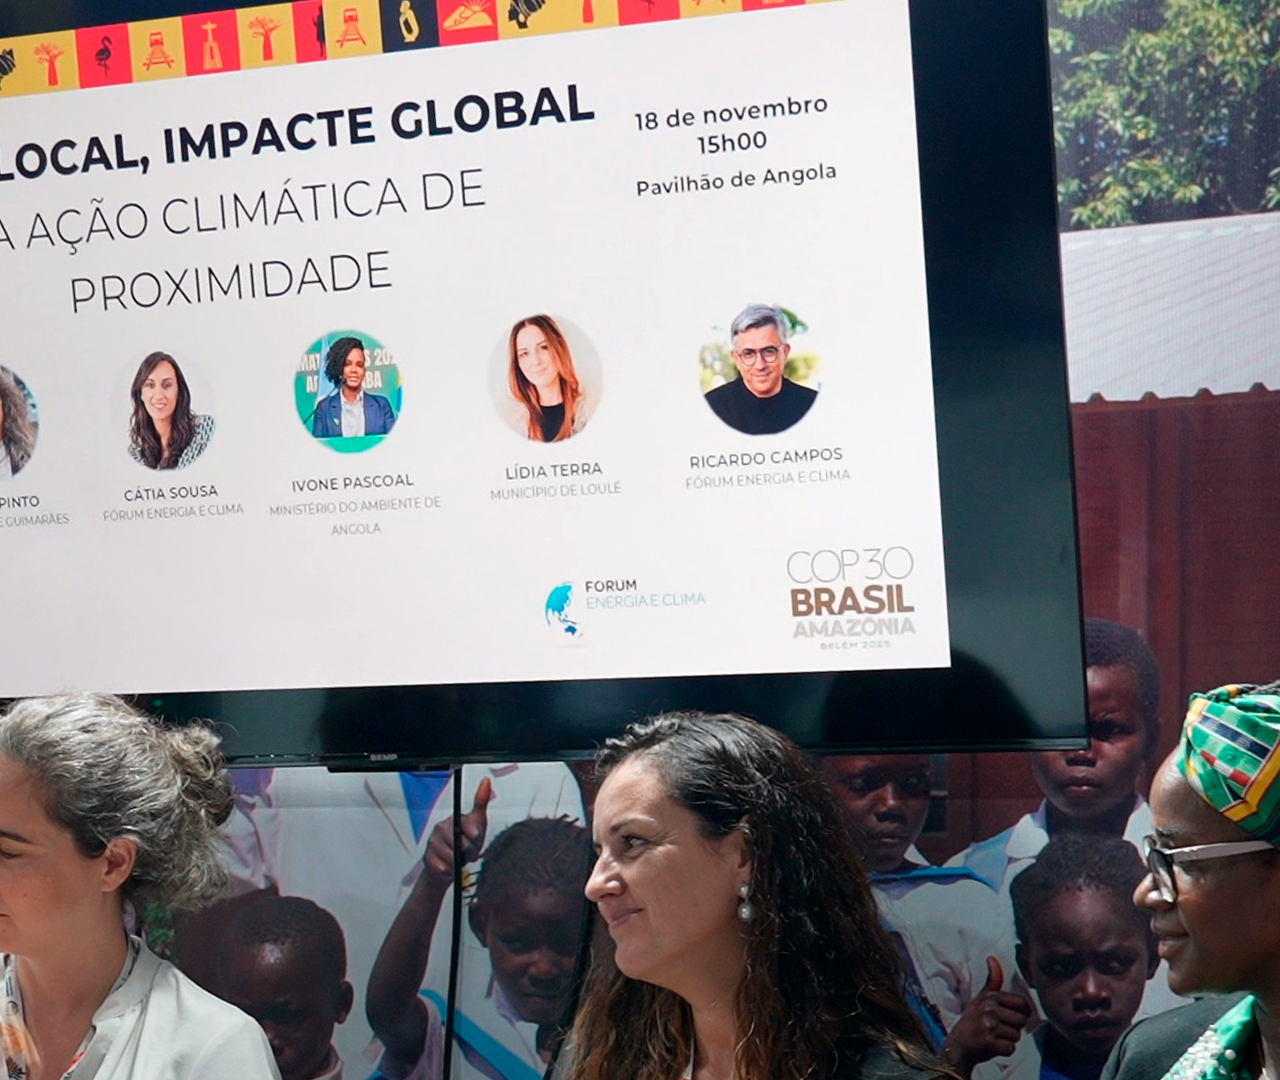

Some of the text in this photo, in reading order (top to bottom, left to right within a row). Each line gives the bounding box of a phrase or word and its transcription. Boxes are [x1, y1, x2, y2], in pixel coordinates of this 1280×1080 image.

[164, 106, 375, 164] IMPACTE
[391, 84, 595, 140] GLOBAL
[635, 97, 828, 131] 18 de novembro
[697, 131, 767, 154] 15h00
[636, 163, 837, 197] Pavilhão de Angola
[27, 197, 148, 255] AÇÃO
[163, 177, 407, 234] CLIMÁTICA
[422, 168, 486, 211] DE
[71, 251, 392, 313] PROXIMIDADE
[690, 448, 843, 469] RICARDO CAMPOS
[506, 462, 603, 480] LÍDIA TERRA
[685, 468, 851, 489] FÓRUM ENERGIA E CLIMA
[292, 474, 414, 492] IVONE PASCOAL
[490, 480, 622, 500] MUNICÍPIO DE LOULÉ
[123, 485, 218, 502] CÁTIA SOUSA
[103, 503, 244, 522] FÓRUM ENERGIA E CLIMA
[269, 496, 441, 516] MINISTÉRIO DO AMBIENTE DE
[5, 512, 69, 527] GUIMARÃES
[331, 523, 382, 536] ANGOLA
[585, 579, 637, 593] FORUM
[586, 592, 706, 610] ENERGIA E CLIMA
[790, 584, 915, 617] BRASIL
[793, 617, 916, 638] AMAZÔNIA
